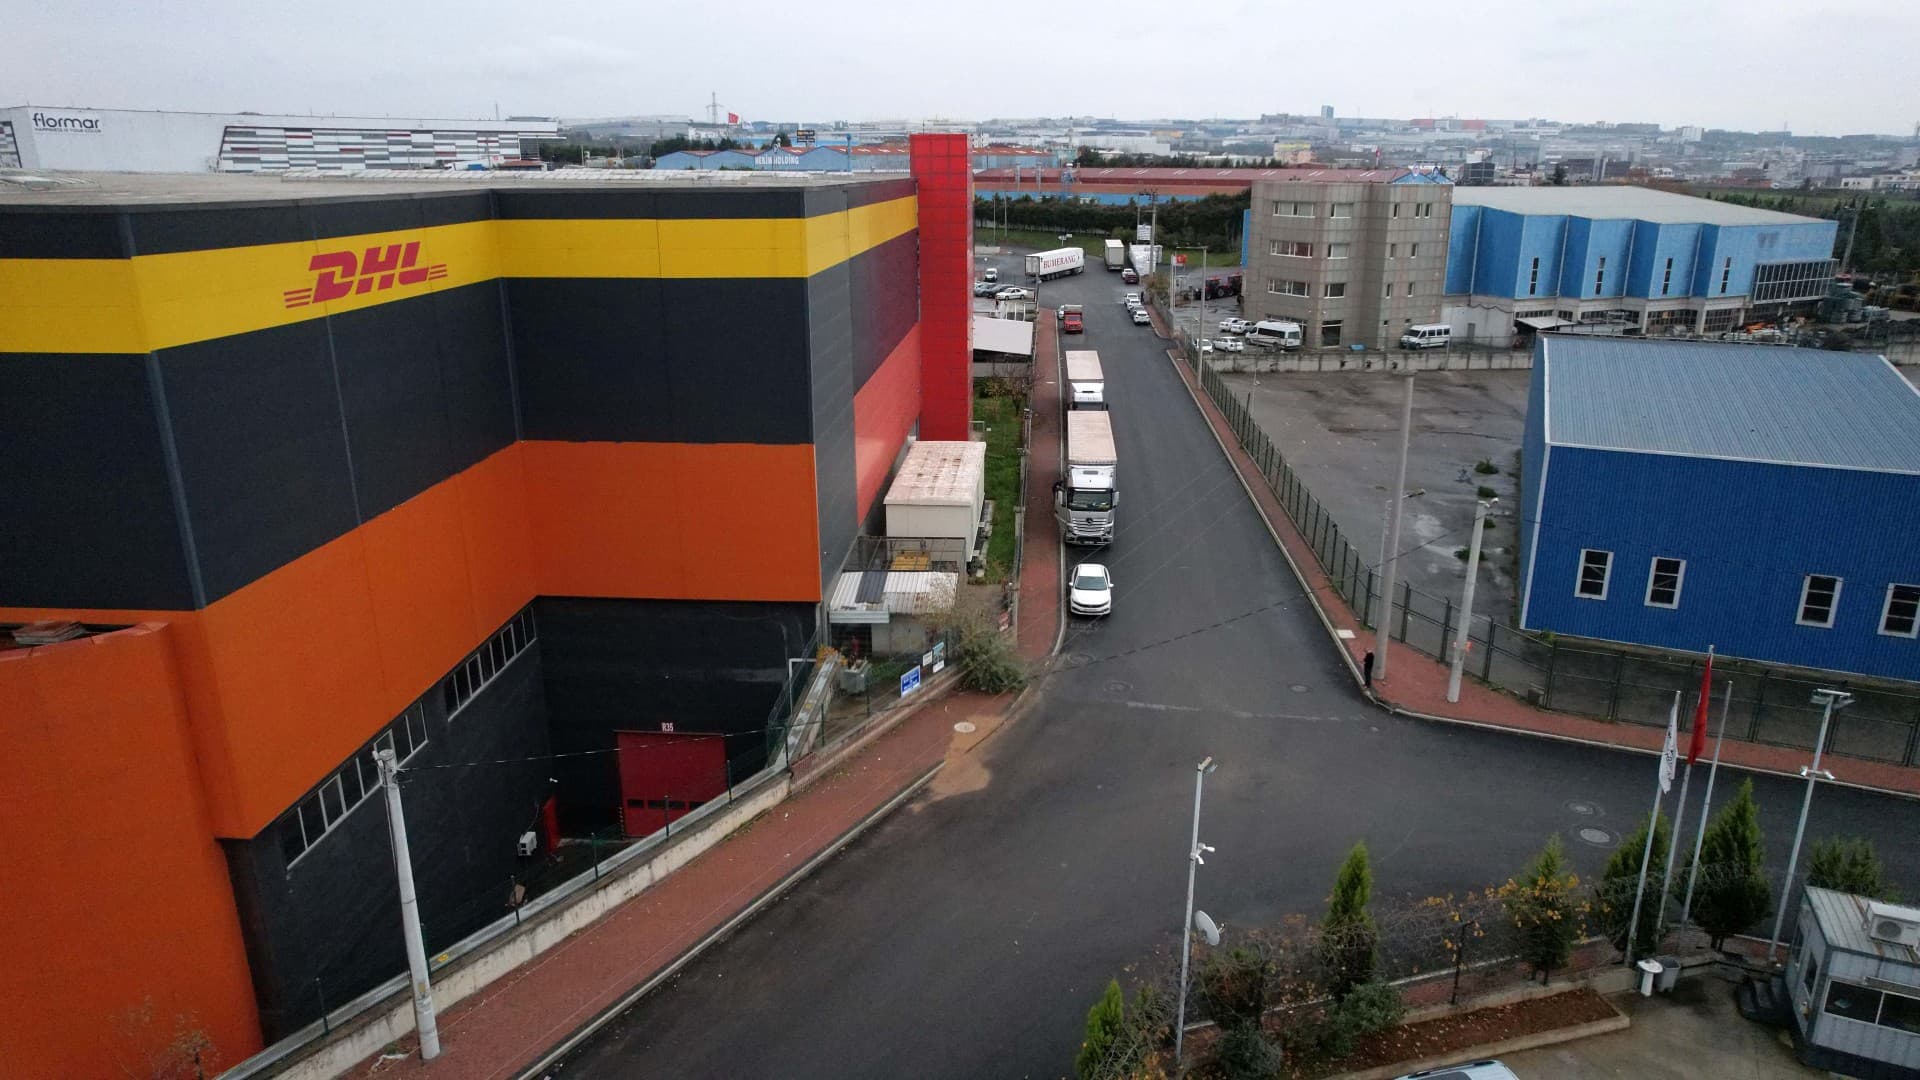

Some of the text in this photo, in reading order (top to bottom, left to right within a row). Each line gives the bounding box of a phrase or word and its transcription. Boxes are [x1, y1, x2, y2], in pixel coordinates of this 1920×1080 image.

[32, 112, 99, 129] flormar
[1043, 254, 1076, 269] BUMERANG
[308, 240, 430, 304] DHL
